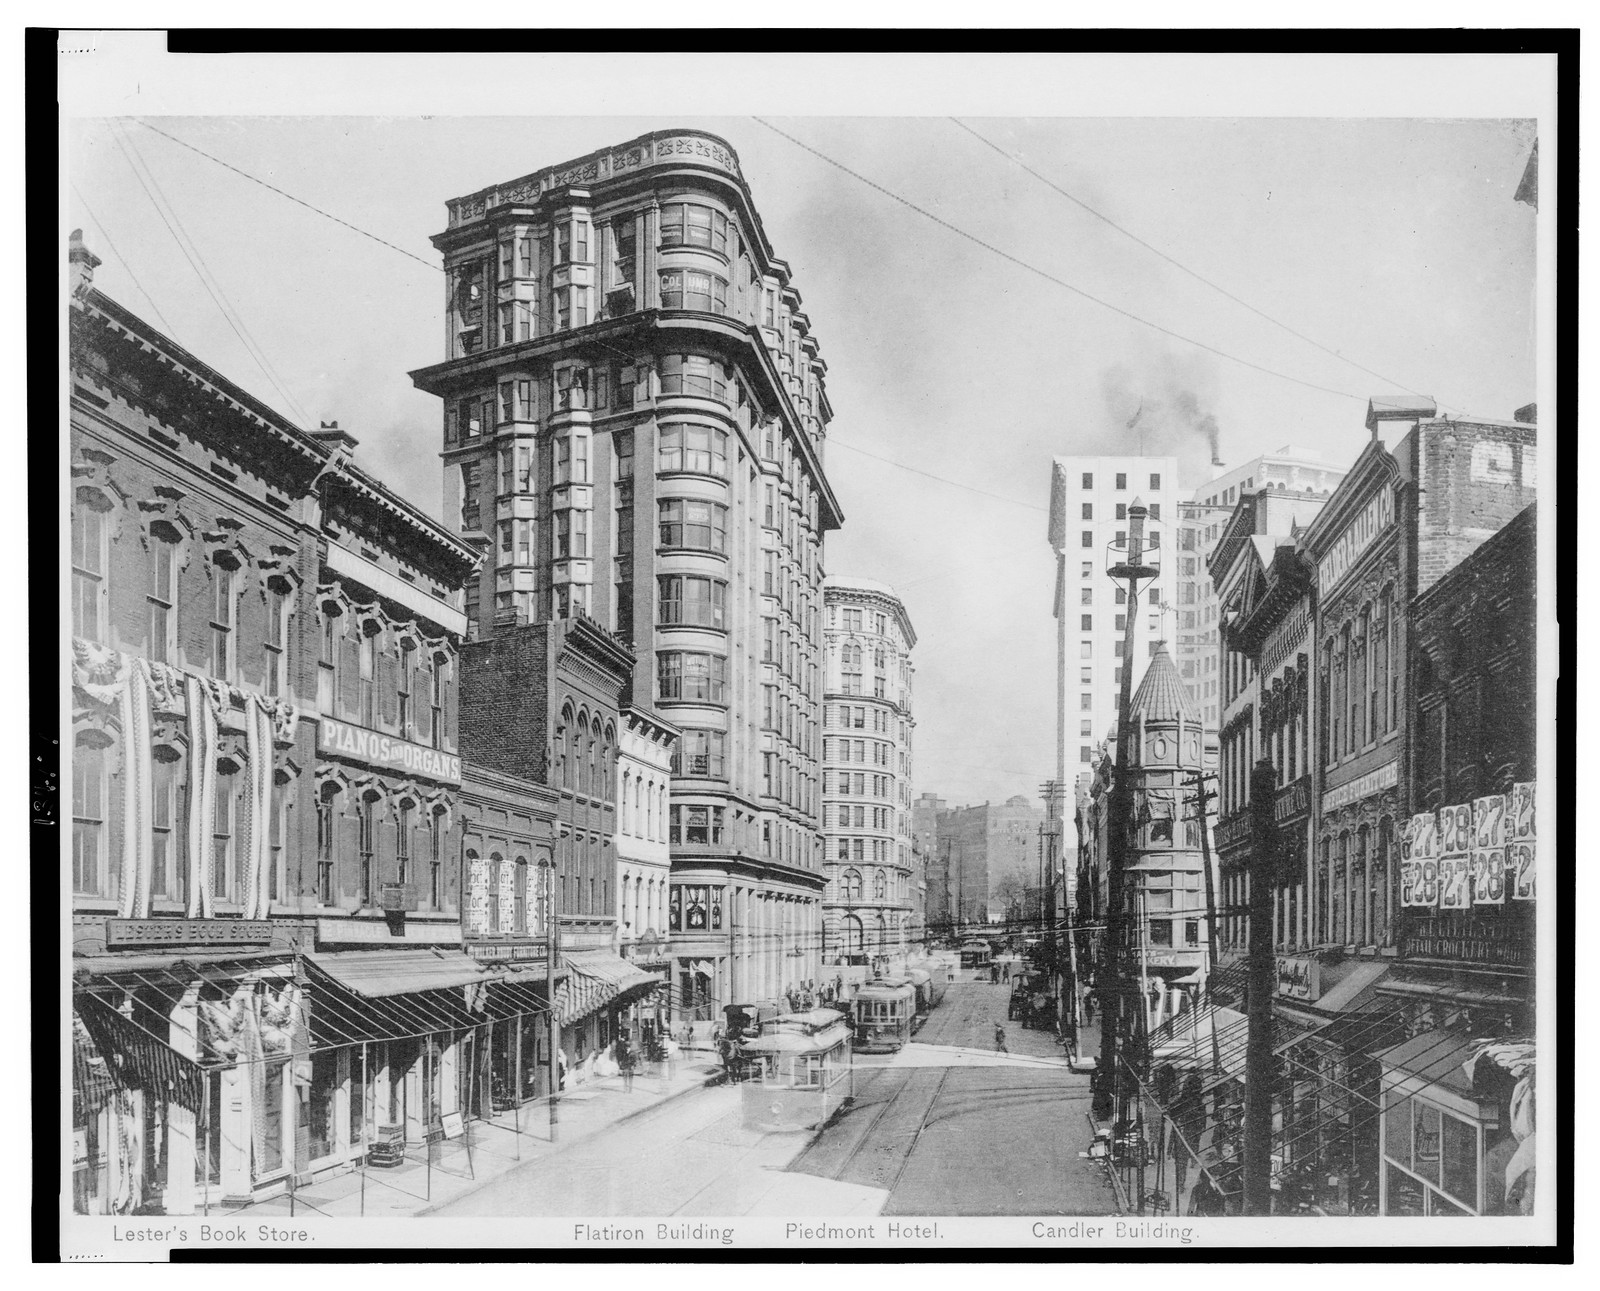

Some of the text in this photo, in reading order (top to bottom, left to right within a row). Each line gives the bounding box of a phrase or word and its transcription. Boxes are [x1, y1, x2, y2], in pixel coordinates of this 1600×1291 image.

[323, 719, 390, 762] PIANOS
[1349, 760, 1398, 802] FURNITURE
[1414, 815, 1436, 858] 27
[1444, 806, 1470, 852] 28
[1478, 796, 1504, 847] 27
[1414, 861, 1437, 903] 28
[1444, 861, 1469, 906] 27
[1478, 852, 1504, 901] 28
[189, 925, 225, 940] BOOK
[230, 925, 272, 940] STORE
